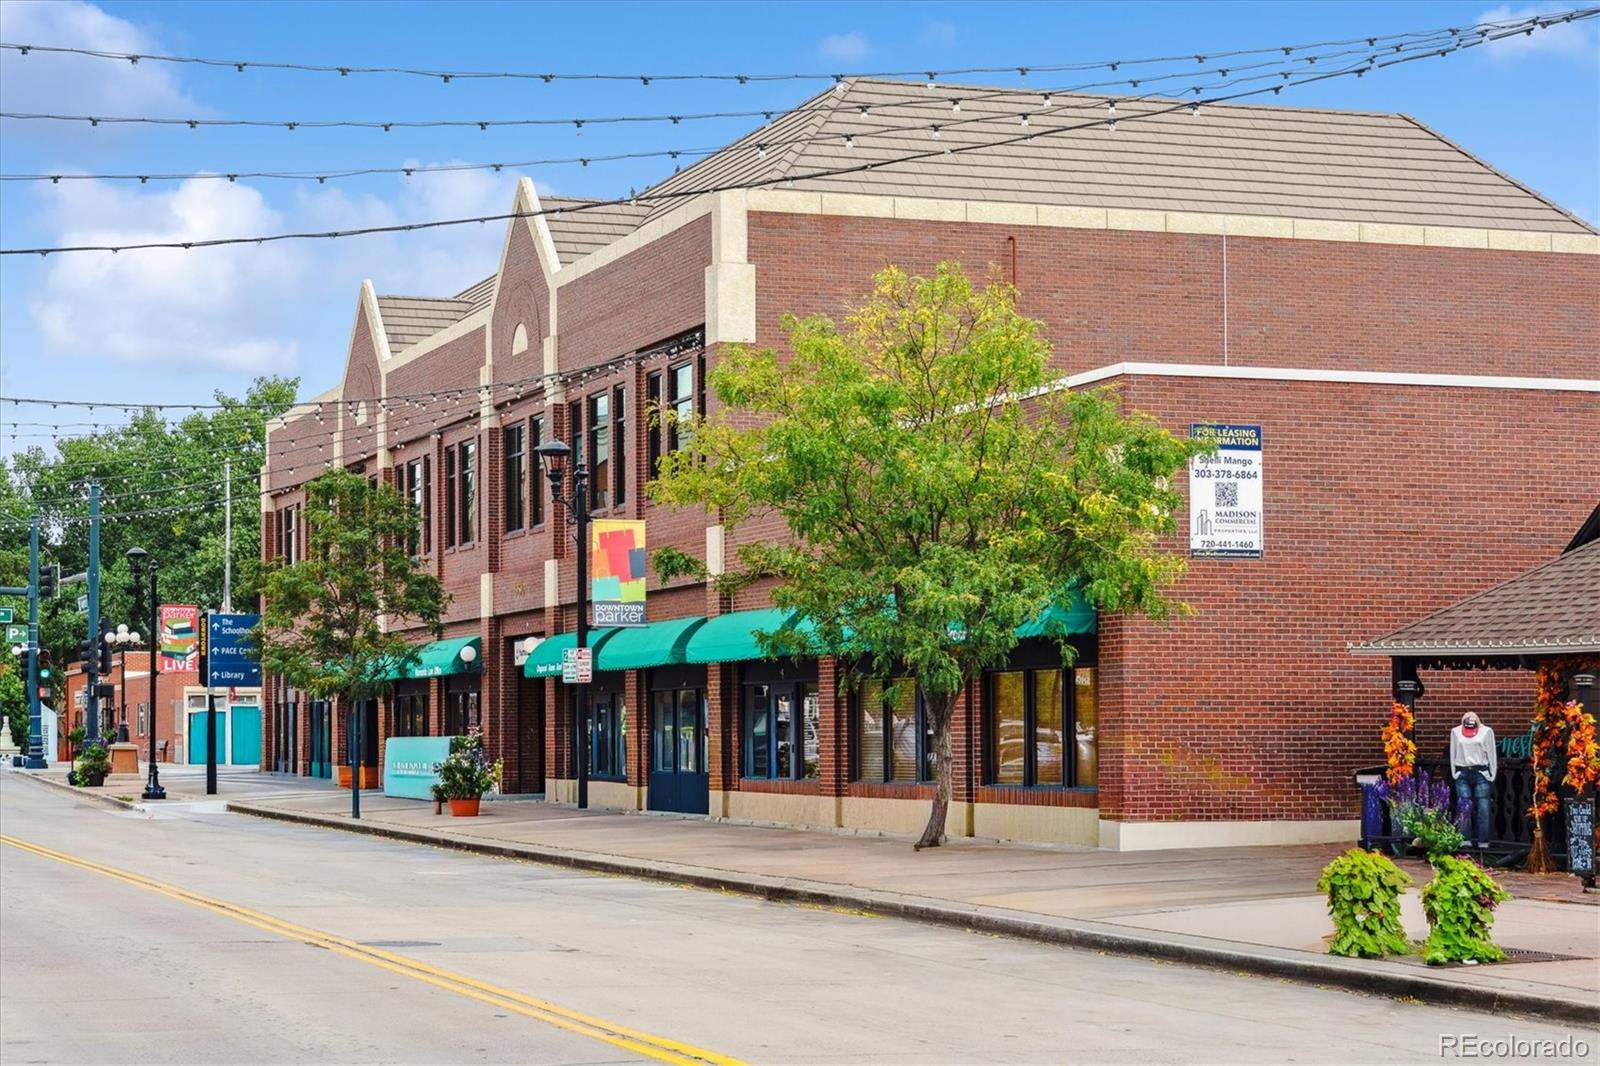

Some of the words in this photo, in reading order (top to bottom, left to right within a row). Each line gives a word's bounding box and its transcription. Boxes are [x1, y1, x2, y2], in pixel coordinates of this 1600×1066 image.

[1197, 428, 1217, 437] FOR
[1218, 429, 1256, 438] LEASING
[1223, 456, 1253, 467] Mango
[1194, 469, 1258, 479] 303-378-6864
[1200, 540, 1254, 549] 720-441-1460
[222, 618, 234, 626] The
[595, 610, 644, 625] parker
[9, 627, 19, 639] P
[221, 647, 237, 655] PACE
[164, 660, 193, 671] LIVE
[221, 671, 245, 681] Library
[1500, 729, 1533, 758] nest
